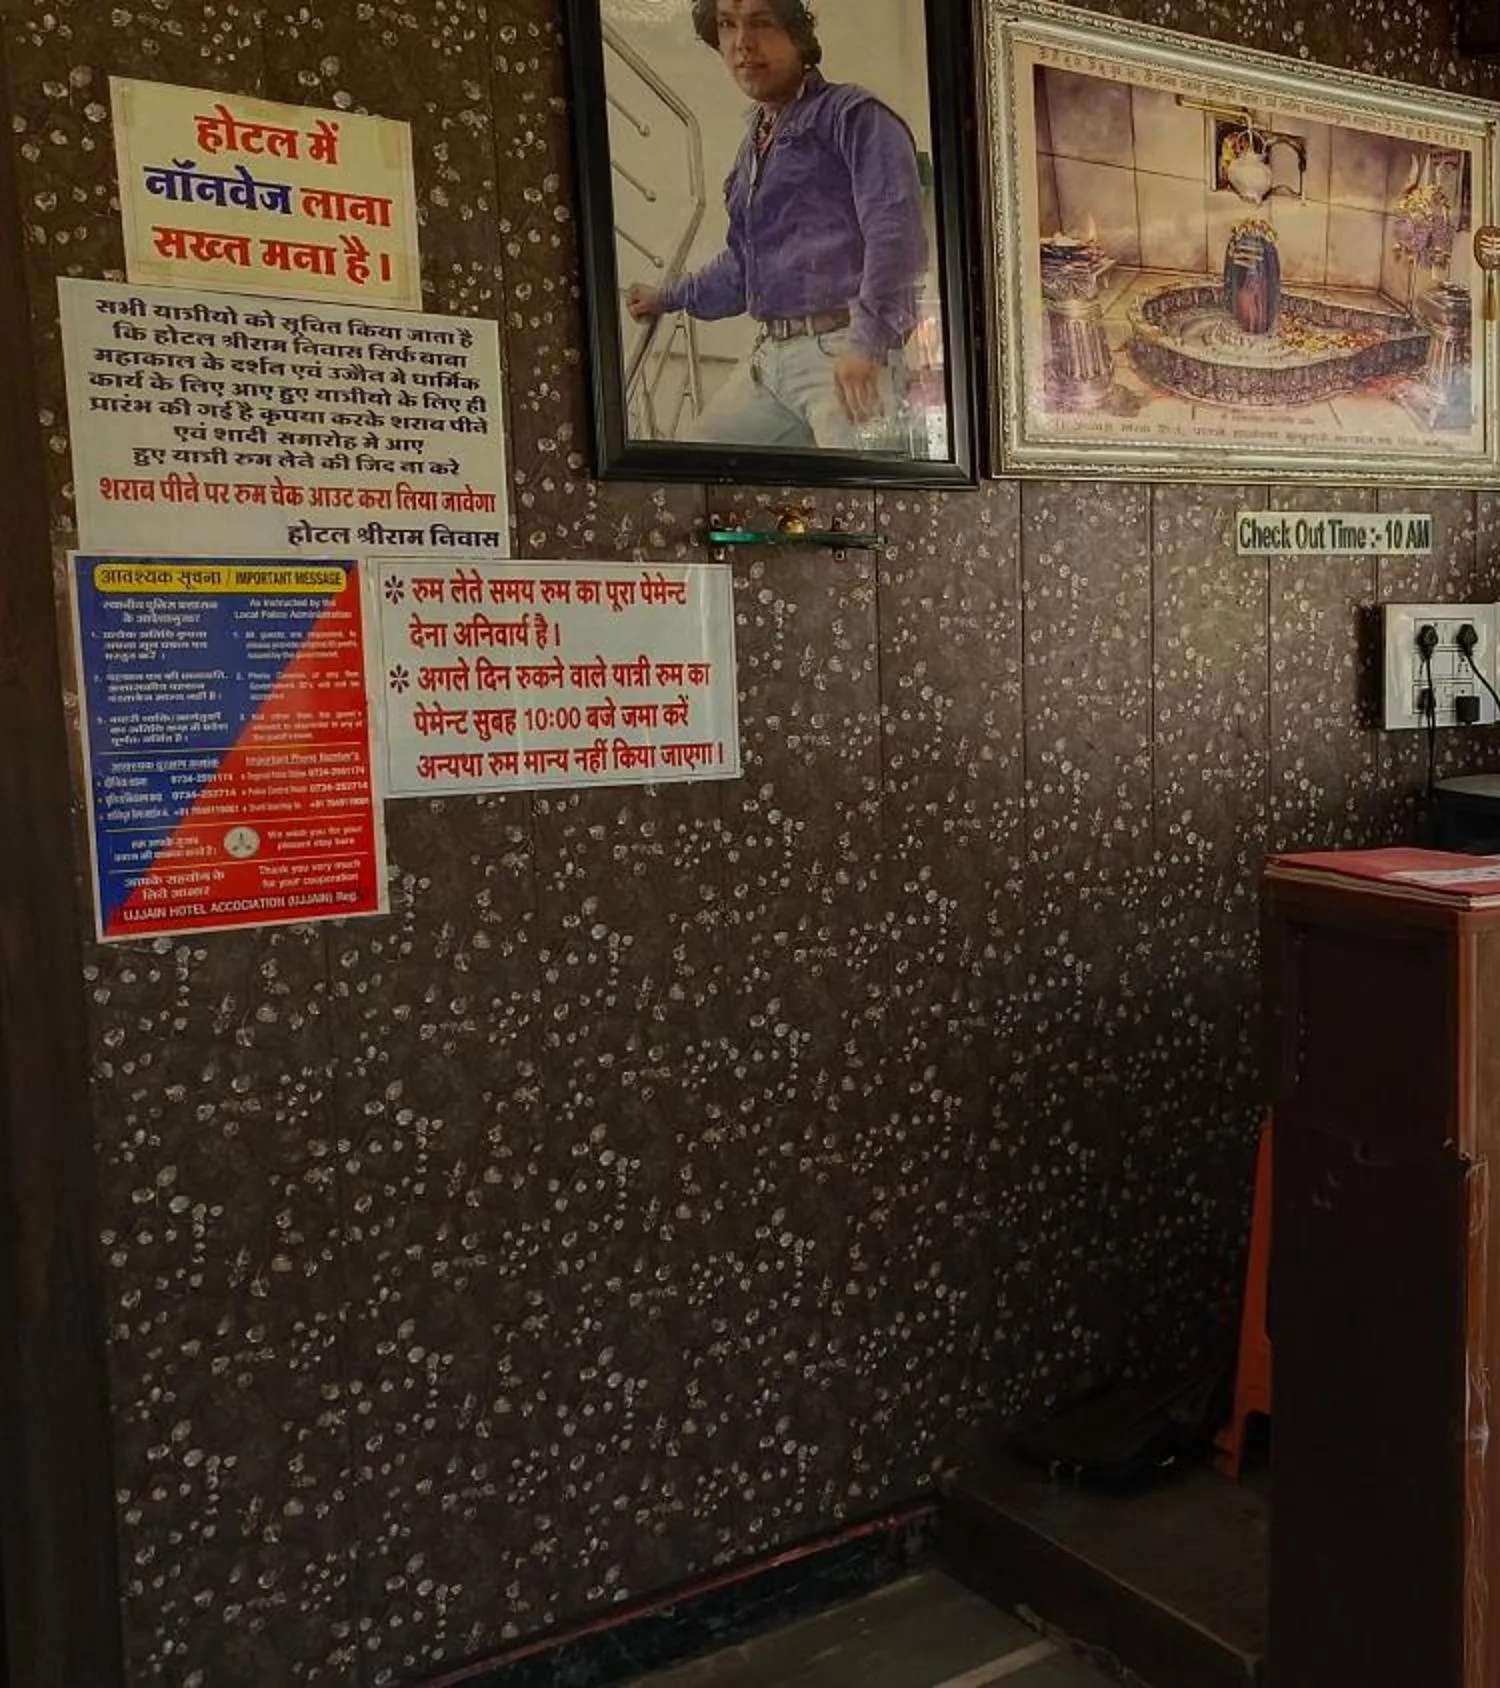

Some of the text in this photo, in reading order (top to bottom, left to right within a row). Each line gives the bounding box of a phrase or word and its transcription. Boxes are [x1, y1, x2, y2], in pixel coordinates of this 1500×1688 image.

[194, 103, 339, 164] होटल में
[143, 158, 393, 227] नॉनवेज लाना
[152, 226, 253, 266] सख्त
[259, 239, 337, 276] मना
[96, 298, 147, 317] सभी
[244, 309, 275, 329] को
[282, 314, 341, 337] सूचित
[348, 319, 401, 340] किया
[407, 328, 454, 345] जाता
[456, 327, 474, 349] है
[113, 320, 147, 342] कि
[152, 324, 214, 347] होटल
[222, 331, 287, 353] श्रीराम
[293, 334, 363, 359] निवास
[94, 348, 195, 369] महाकाल
[202, 352, 225, 372] के
[231, 356, 285, 377] दर्शन
[291, 360, 322, 381] एवं
[89, 370, 145, 390] कार्य
[150, 372, 173, 392] के
[180, 373, 225, 398] लिए
[231, 384, 273, 401] आए
[279, 386, 309, 405] हुए
[398, 390, 417, 409] के
[422, 392, 461, 414] लिए
[466, 395, 486, 414] ही
[159, 397, 191, 417] की
[197, 400, 234, 421] गई
[238, 401, 254, 422] है
[259, 408, 324, 427] कृपया
[330, 409, 385, 429] करके
[174, 422, 207, 442] एवं
[213, 425, 267, 444] शादी
[277, 430, 357, 450] समारोह
[385, 437, 424, 454] आए
[132, 447, 166, 466] हुए
[172, 447, 228, 465] यात्री
[278, 450, 314, 469] लेने
[321, 453, 349, 471] की
[356, 454, 395, 473] जिद
[400, 460, 424, 475] ना
[429, 457, 460, 476] करे
[99, 476, 155, 502] शराब
[160, 472, 200, 504] पीने
[204, 482, 229, 504] पर
[271, 476, 304, 506] चेक
[309, 485, 353, 508] आउट
[357, 488, 392, 510] करा
[396, 482, 438, 512] लिया
[441, 484, 497, 513] जावेगा
[288, 519, 500, 548] होटल श्रीराम निवास
[1239, 517, 1291, 549] Check
[1295, 519, 1325, 549] Out
[1385, 519, 1403, 549] 10
[1406, 519, 1430, 549] AM
[100, 568, 222, 591] आवश्यक सूचना
[235, 571, 342, 585] IMPORTANT MESSAGE
[450, 569, 483, 604] लेते
[489, 578, 535, 604] समय
[576, 581, 600, 604] का
[606, 580, 636, 612] पूरा
[640, 572, 687, 605] पेमेन्ट
[409, 613, 448, 647] देना
[453, 613, 529, 648] अनिवार्य
[417, 656, 470, 692] अगले
[475, 656, 511, 691] दिन
[516, 655, 565, 690] रुकने
[570, 655, 607, 689] वाले
[612, 655, 651, 687] यात्री
[686, 663, 710, 686] का
[414, 695, 690, 741] पेमेन्ट सुबह 10:00 बजे जमा करें
[417, 753, 482, 780] अन्यथा
[524, 749, 569, 775] मान्य
[574, 738, 607, 773] नहीं
[613, 737, 656, 770] किया
[123, 905, 167, 921] UJJAIN
[169, 903, 207, 918] HOTEL
[210, 895, 286, 913] ACCOCIATION
